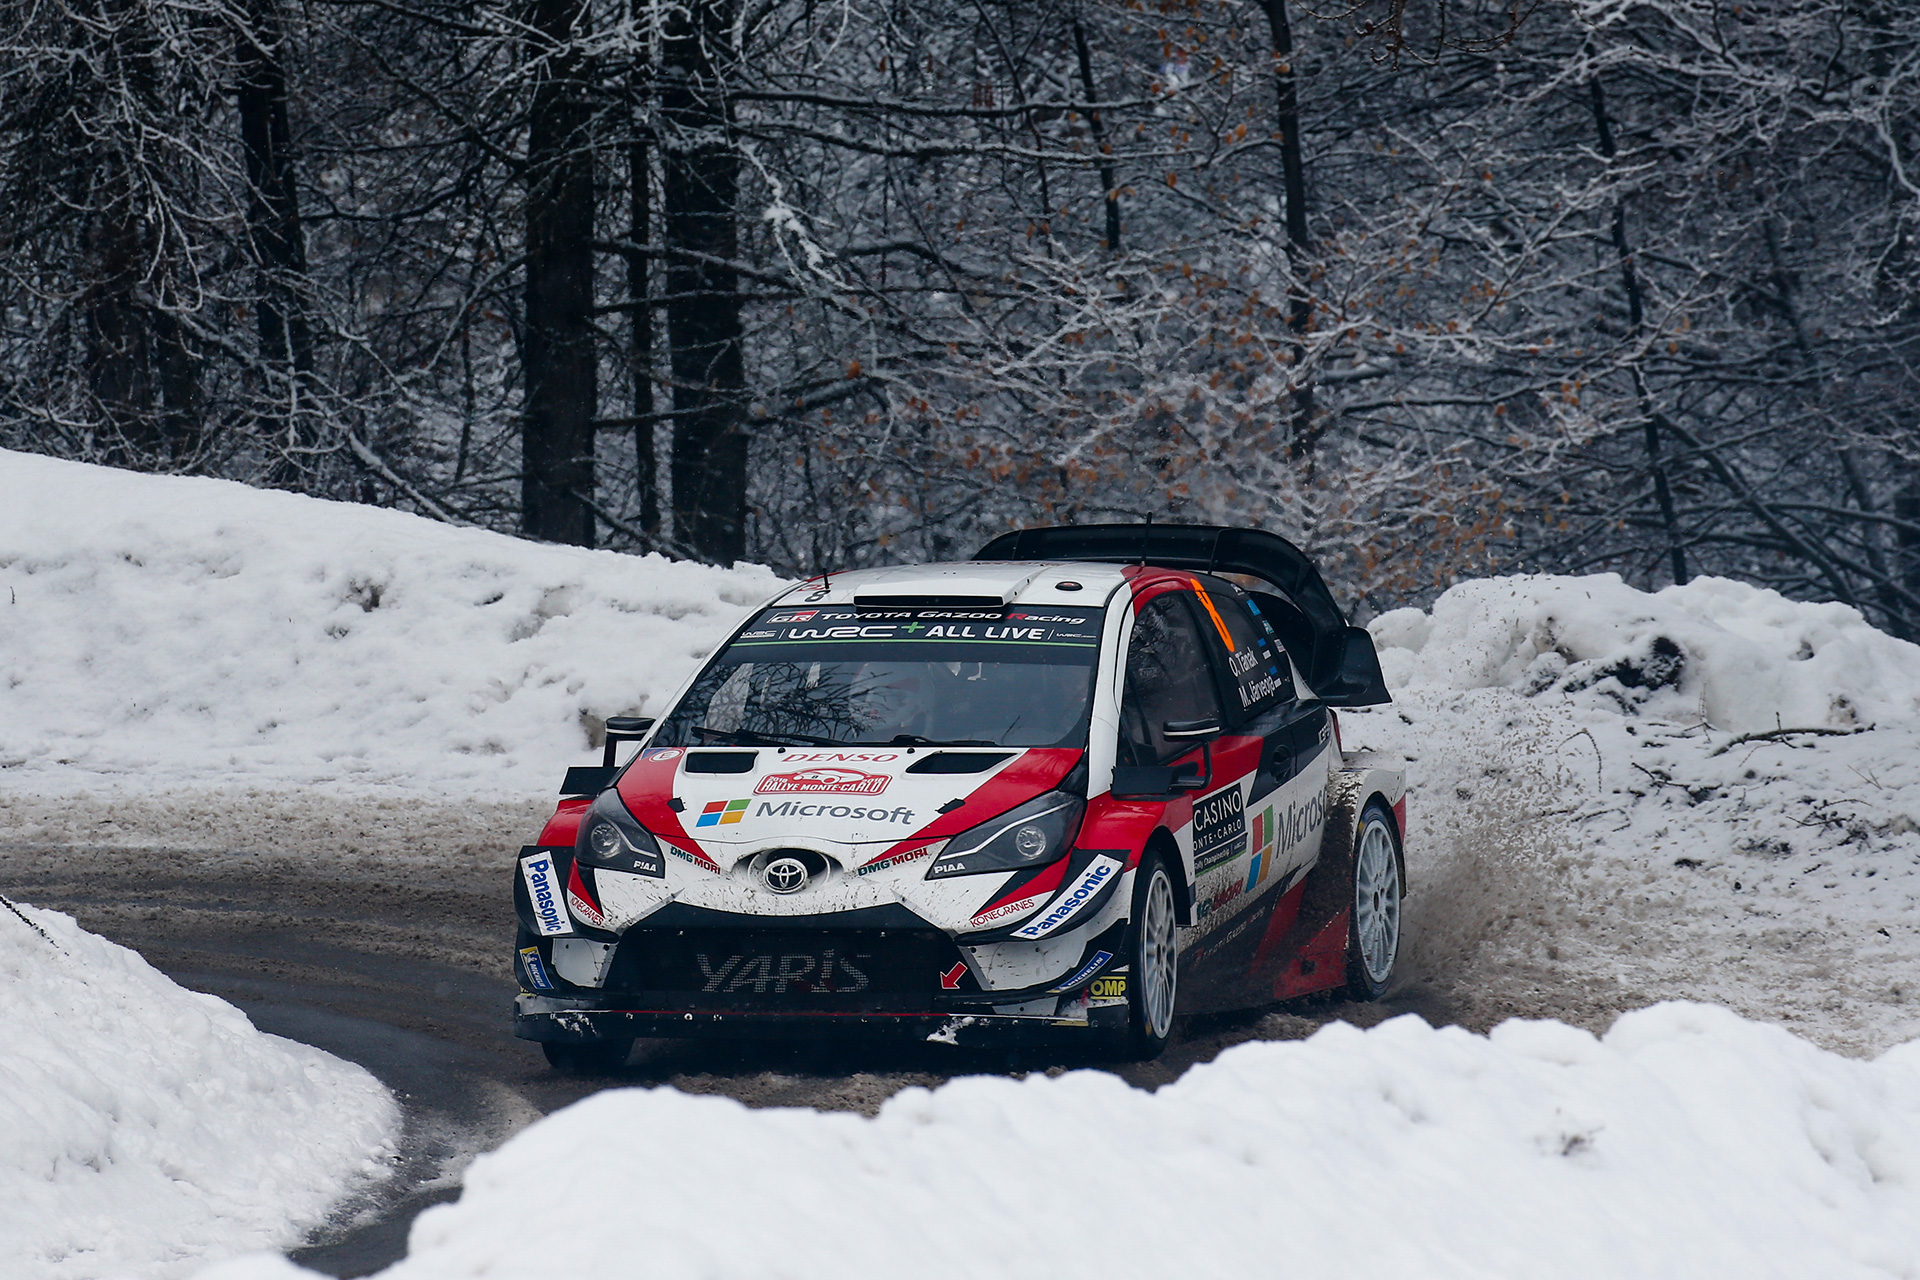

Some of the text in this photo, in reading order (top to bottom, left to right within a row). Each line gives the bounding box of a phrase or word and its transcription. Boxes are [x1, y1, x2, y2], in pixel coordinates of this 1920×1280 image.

[805, 590, 831, 602] 8
[821, 611, 1086, 624] TOYOTA GAZOO Racing
[925, 625, 976, 638] ALL
[984, 626, 1045, 639] LIVE
[1229, 656, 1241, 678] O.
[1238, 685, 1252, 708] M.
[781, 753, 899, 762] DENSO
[762, 781, 799, 792] RALLYE
[755, 801, 915, 825] Microsoft
[1194, 791, 1242, 831] CASINO
[1276, 784, 1327, 859] Micros
[633, 860, 657, 872] PIAA
[669, 845, 721, 875] DMG MORI
[857, 848, 928, 876] DMG MORI
[933, 862, 966, 874] PIAA
[528, 859, 565, 932] Panasonic
[1020, 864, 1112, 937] Panasonic
[970, 898, 1035, 928] KONECRANES
[1067, 956, 1104, 987] MICHELIN
[1090, 980, 1127, 996] OMP
